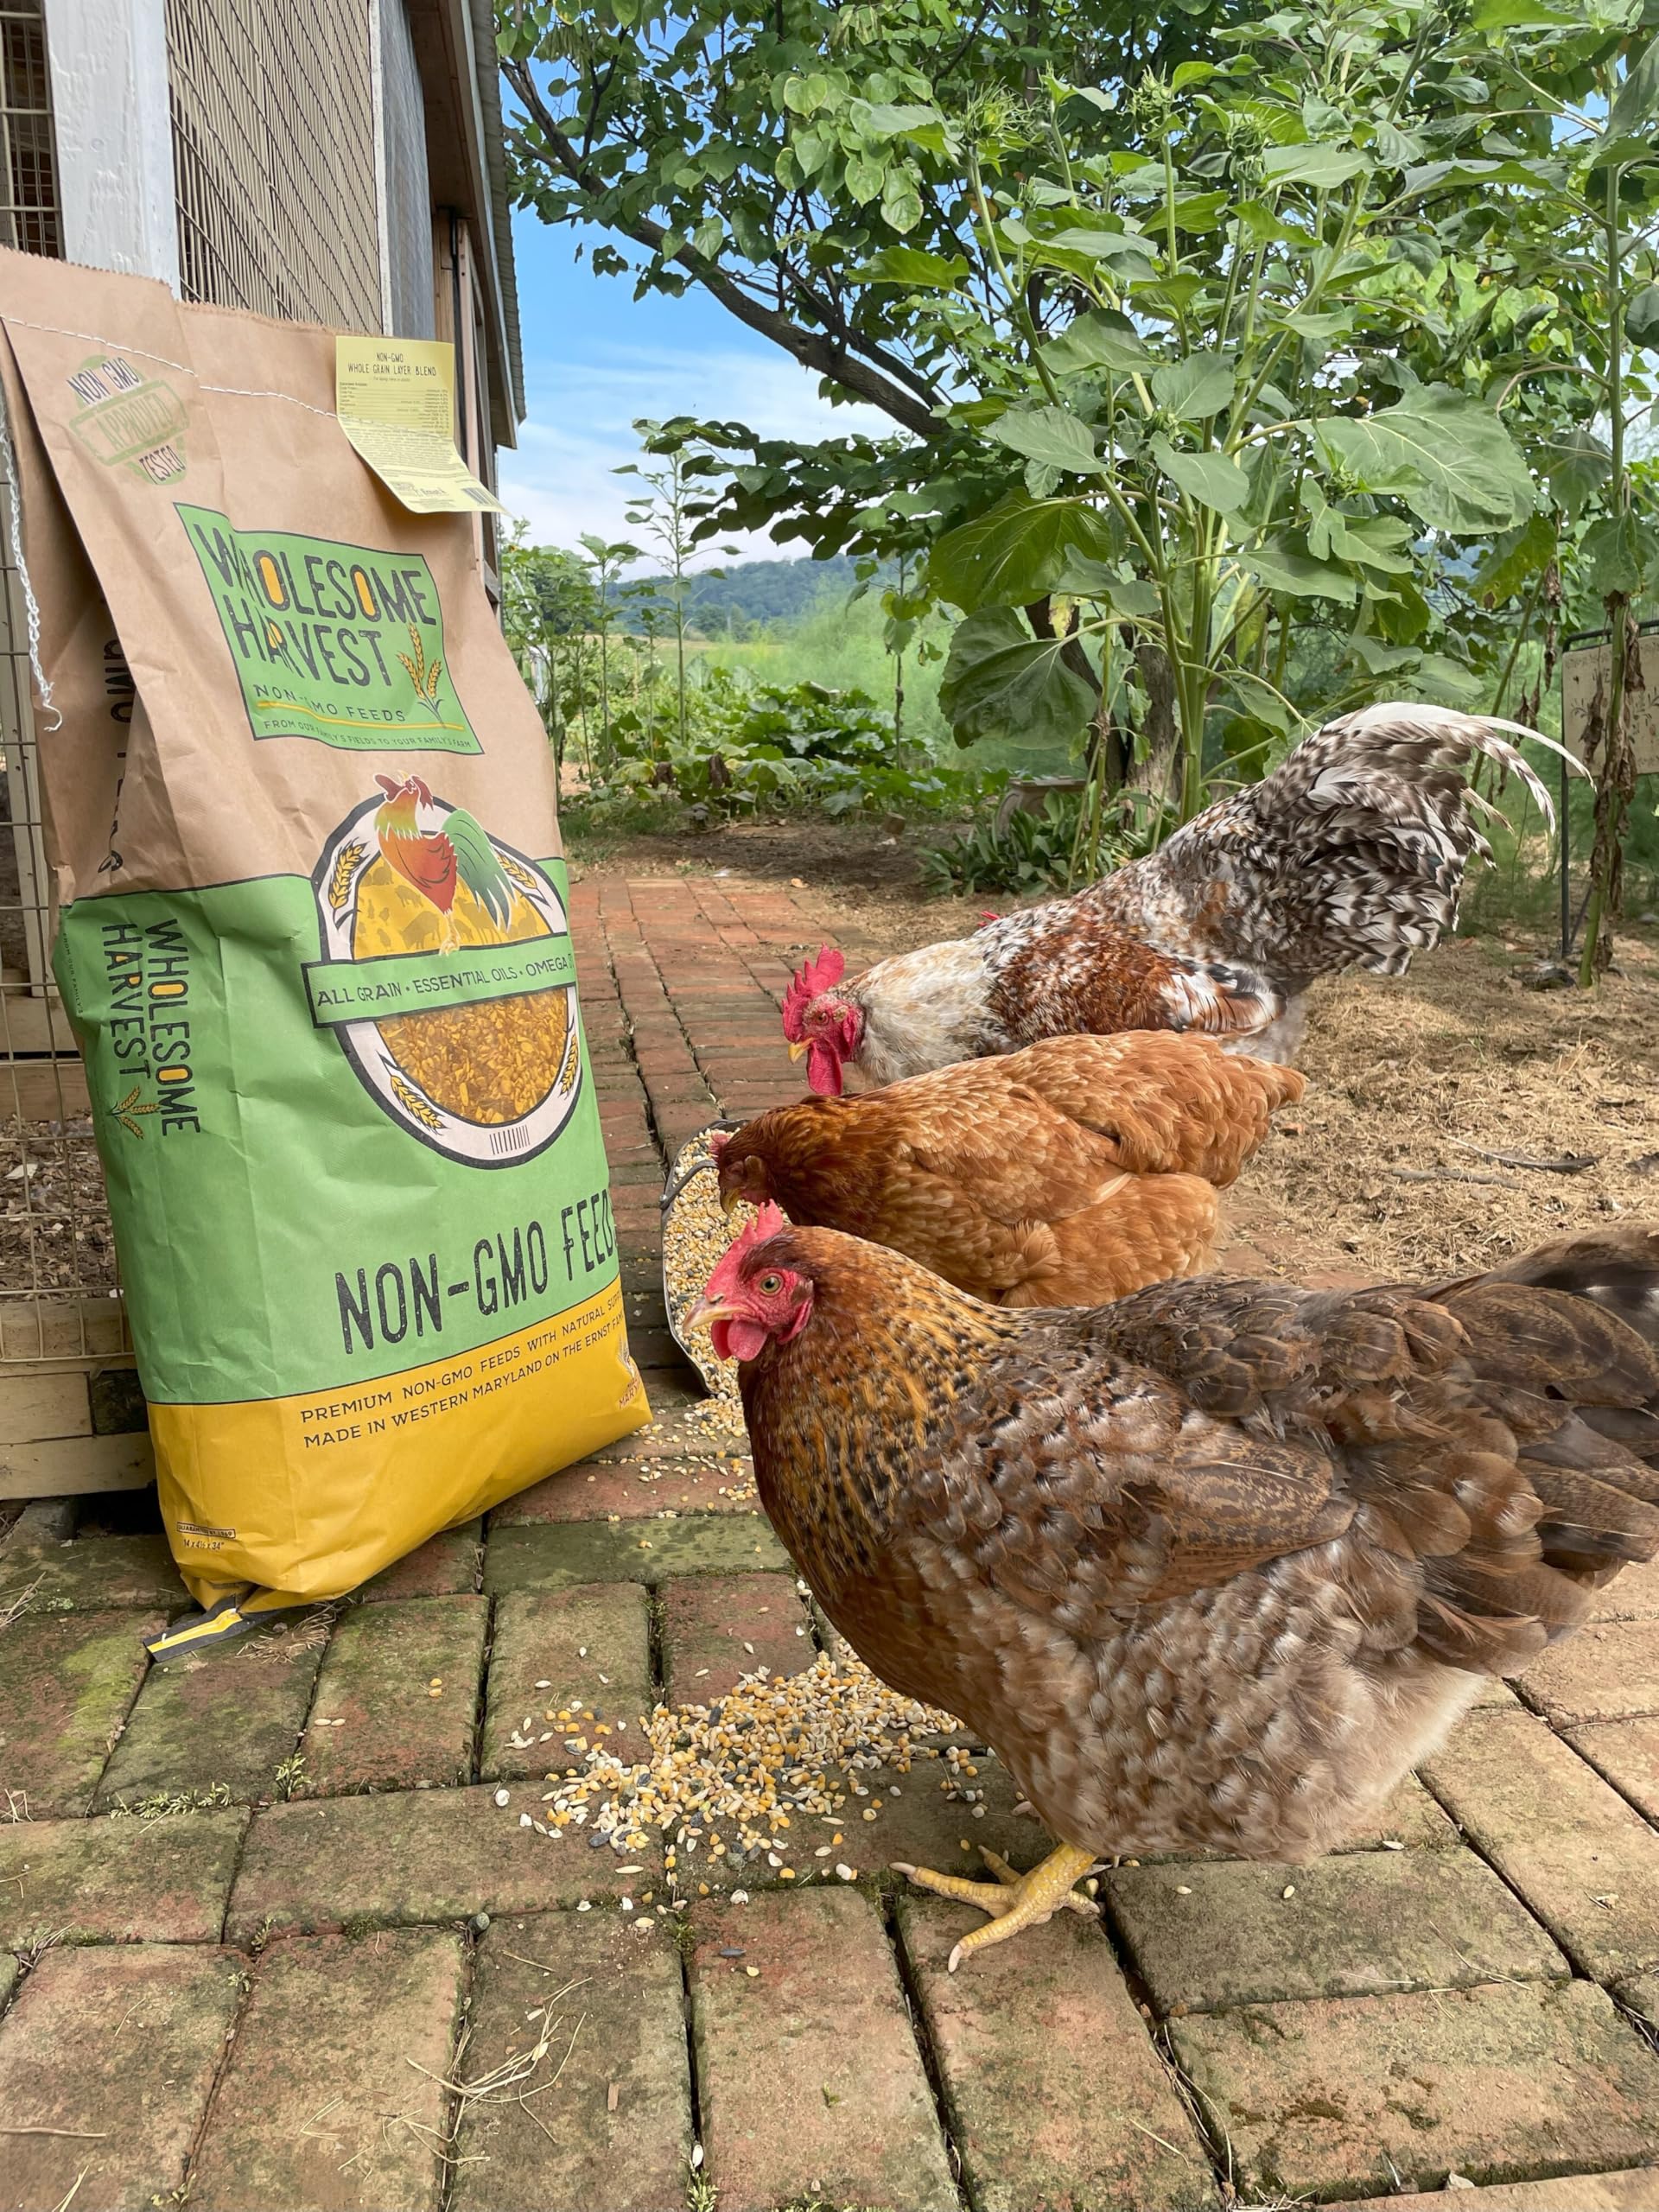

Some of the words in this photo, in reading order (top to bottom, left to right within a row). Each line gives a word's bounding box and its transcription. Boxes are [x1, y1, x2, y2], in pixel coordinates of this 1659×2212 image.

[67, 369, 111, 404] NON
[101, 357, 140, 390] GMO
[347, 363, 369, 373] WHOLE
[373, 364, 390, 374] GRAIN
[394, 365, 411, 375] LAYER
[416, 366, 436, 376] BLEND
[377, 353, 404, 363] NON-GMO
[139, 445, 186, 485] TESTED
[194, 524, 436, 626] WHOLESOME
[223, 594, 392, 686] HARVEST
[264, 720, 295, 729] FROM
[347, 734, 377, 745] FIELDS
[453, 739, 472, 747] FARM
[346, 706, 405, 721] FEEDS
[101, 924, 150, 1078] HARVEST
[317, 988, 354, 1007] ALL
[357, 982, 403, 1001] GRAIN
[412, 969, 489, 994] ESSENTIAL
[493, 966, 518, 981] OILS
[525, 957, 568, 976] OMEGA
[145, 918, 200, 1136] WHOLESOME
[335, 1221, 548, 1354] NON-GMO
[562, 1189, 615, 1281] FEED
[301, 1392, 392, 1422] PREMIUM
[402, 1366, 472, 1399] NON-GMO
[480, 1346, 520, 1372] FEEDS
[527, 1331, 556, 1351] WITH
[562, 1306, 605, 1336] NATURAL
[304, 1425, 361, 1447] MADE
[368, 1419, 385, 1433] IN
[391, 1391, 467, 1427] WESTERN
[473, 1360, 542, 1399] MARYLAND
[545, 1351, 559, 1366] ON
[563, 1340, 582, 1357] THE
[586, 1323, 610, 1347] ERNST
[612, 1312, 624, 1331] FAM
